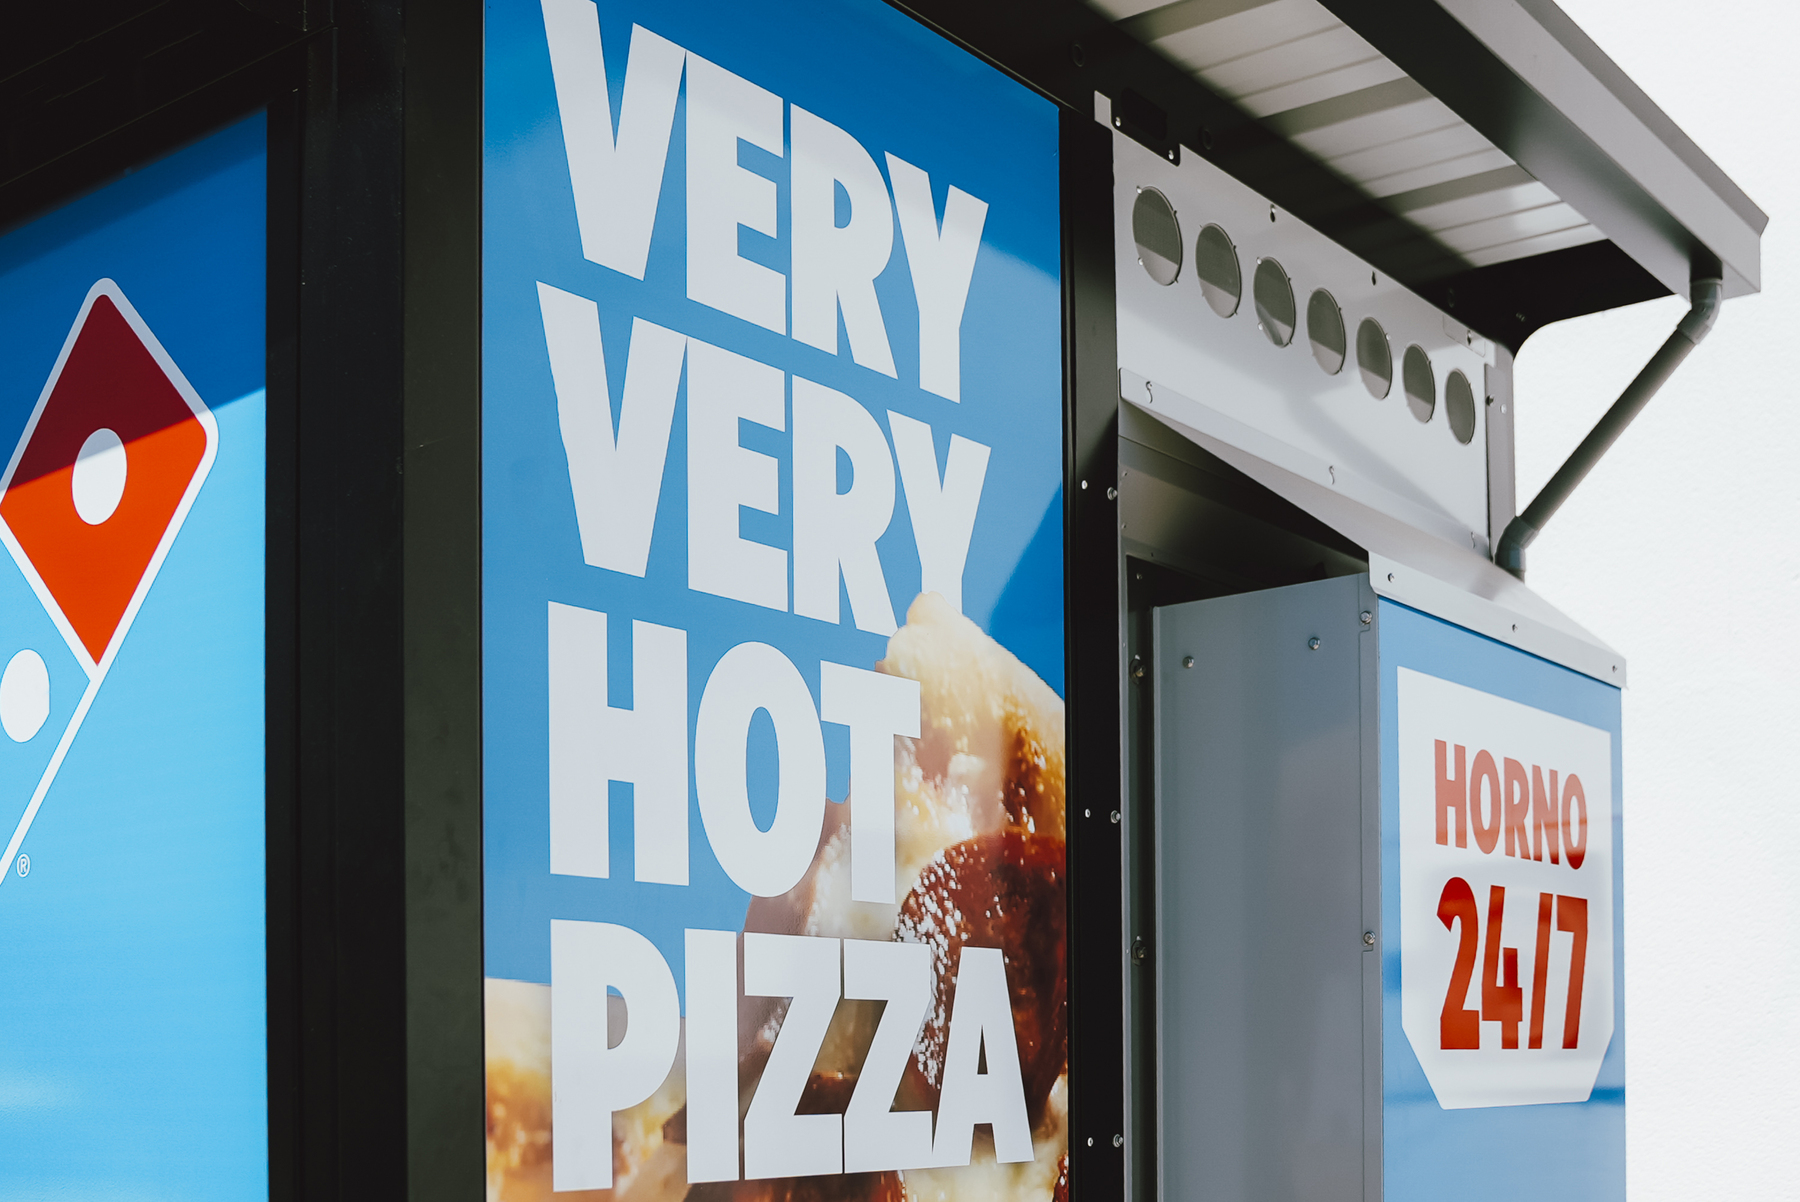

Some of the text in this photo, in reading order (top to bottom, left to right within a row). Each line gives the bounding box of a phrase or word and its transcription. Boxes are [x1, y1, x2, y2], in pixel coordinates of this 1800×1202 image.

[540, 0, 989, 404] VERY
[535, 280, 992, 638] VERY
[547, 600, 921, 905] HOT
[1434, 738, 1588, 870] HORNO
[550, 919, 1034, 1192] PIZZA
[1436, 876, 1588, 1050] 24/7
